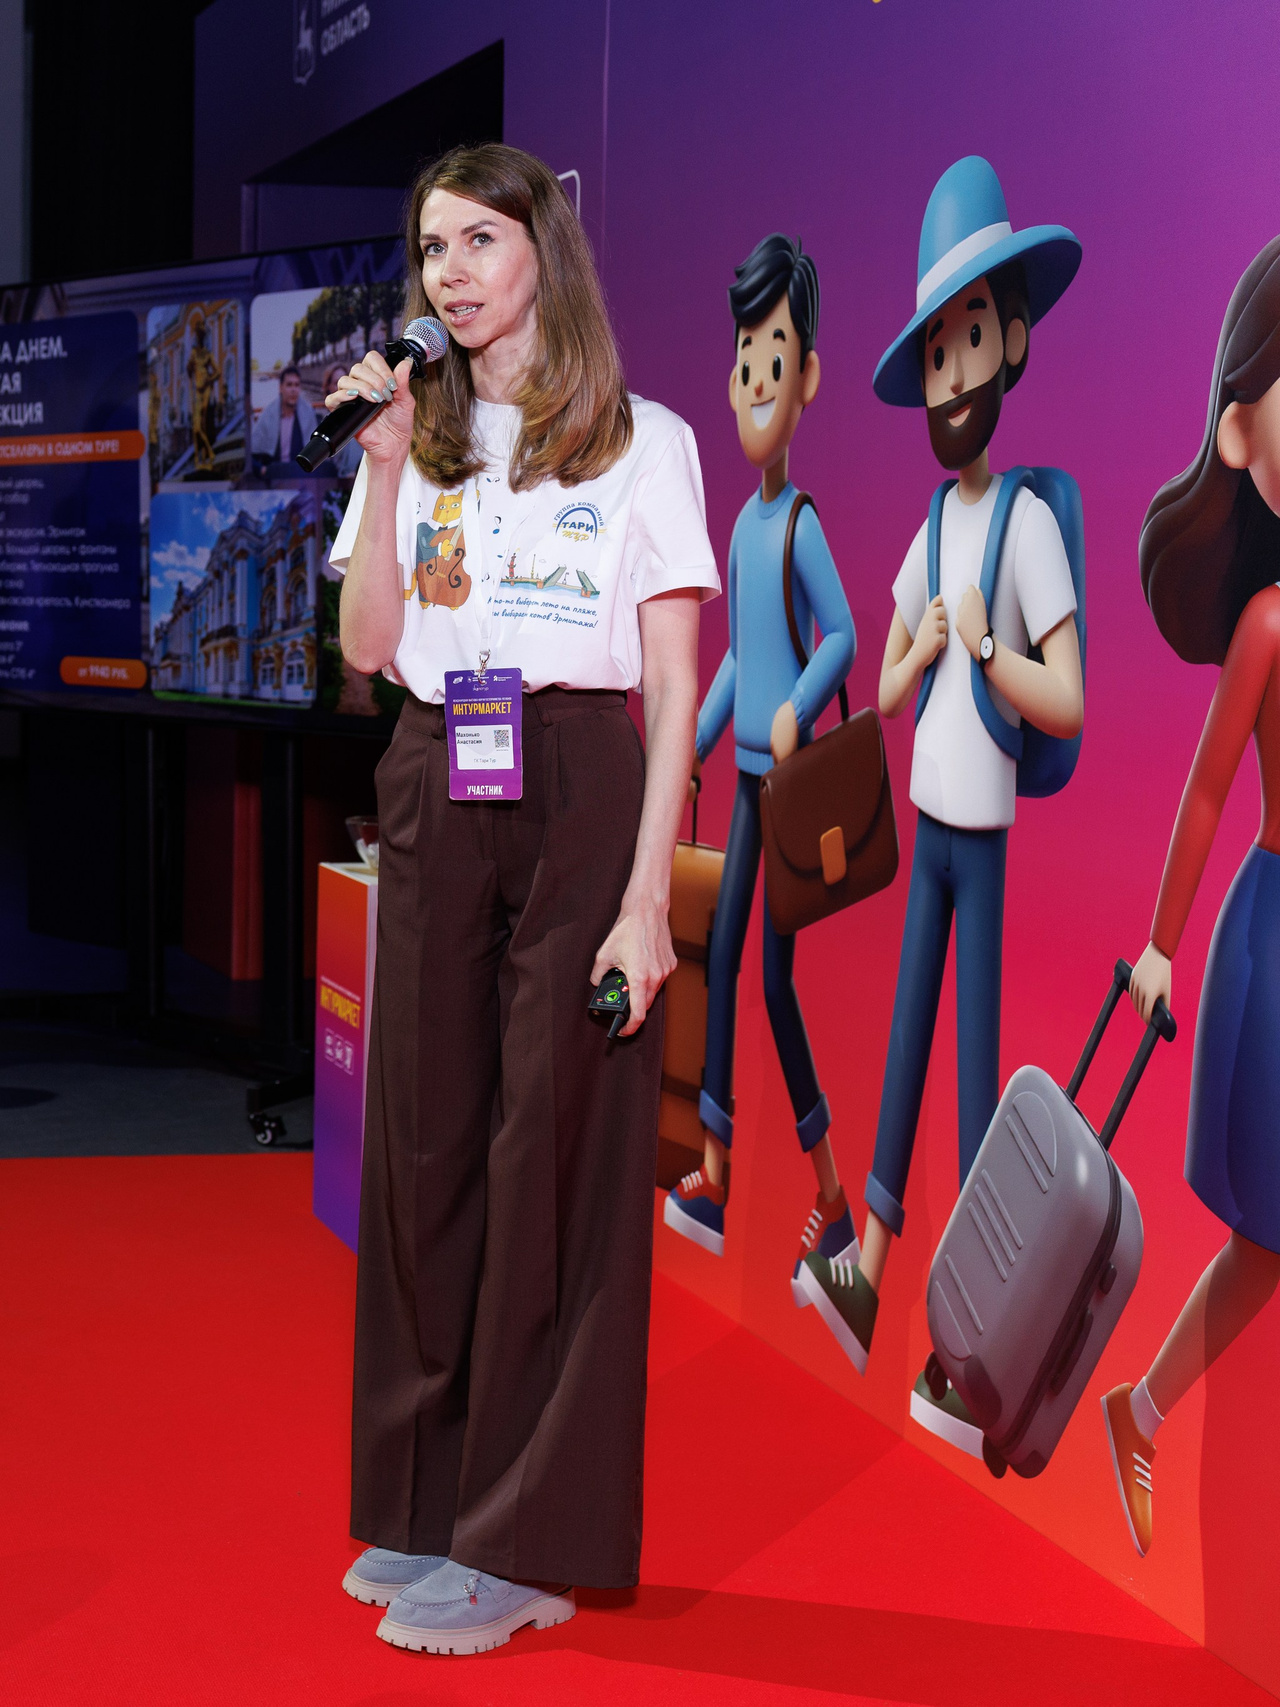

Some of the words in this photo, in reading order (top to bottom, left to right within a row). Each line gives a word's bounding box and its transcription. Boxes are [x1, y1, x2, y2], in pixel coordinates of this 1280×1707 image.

[15, 336, 68, 365] ДНЕМ.
[553, 503, 576, 521] группа
[577, 501, 605, 527] компаний
[562, 521, 594, 533] ТАРИ
[572, 607, 597, 616] пляже,
[529, 612, 552, 620] котов
[552, 613, 599, 628] Эрмитажа!
[453, 702, 512, 716] ИНТУРМАРКЕТ
[466, 785, 503, 796] УЧАСТНИК
